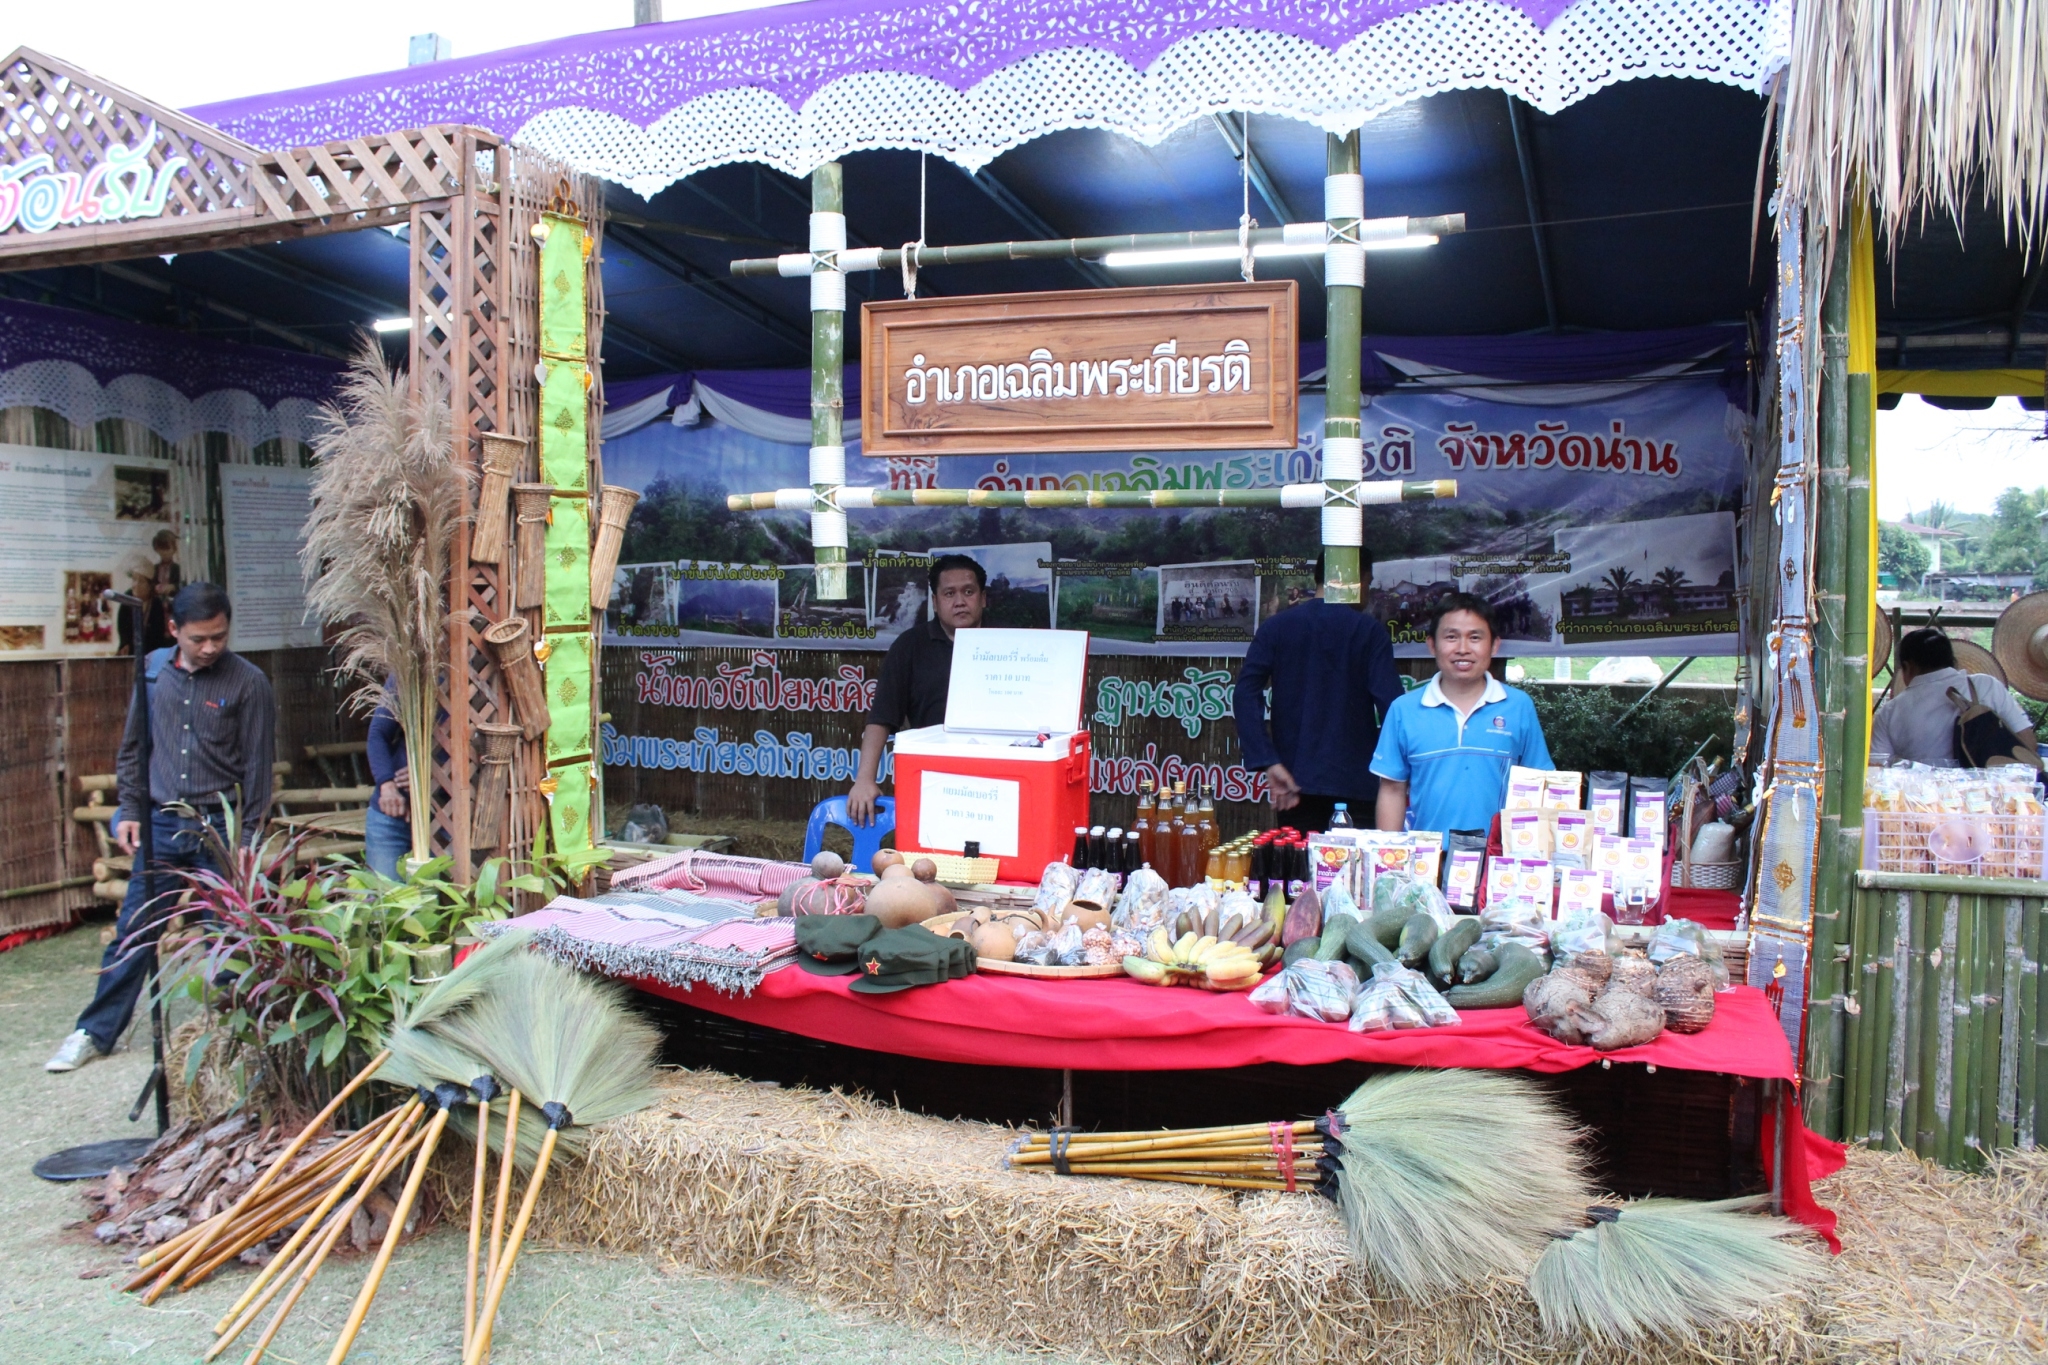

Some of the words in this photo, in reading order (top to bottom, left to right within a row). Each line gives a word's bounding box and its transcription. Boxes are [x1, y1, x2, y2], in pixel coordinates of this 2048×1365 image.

[902, 338, 1252, 405] อำเภอเฉลิมพระเกียรติ
[977, 426, 1413, 494] อำเภอเฉลิมพระเกีรติ
[1437, 421, 1680, 476] จังหวัดน่าน
[776, 613, 877, 639] น้ำตกวังเปียง
[1555, 617, 1739, 634] ที่ว่าการอำเภอเฉลิมพระเกียรติ
[972, 647, 1019, 662] น้ำมัลเบอร์รี่
[1015, 674, 1031, 682] บาท
[1094, 667, 1236, 739] ฐานสู้ร
[943, 785, 999, 801] แยมมัลเบอร์รี่
[945, 808, 964, 818] ราคา
[965, 811, 975, 819] 30
[977, 812, 994, 822] บาท
